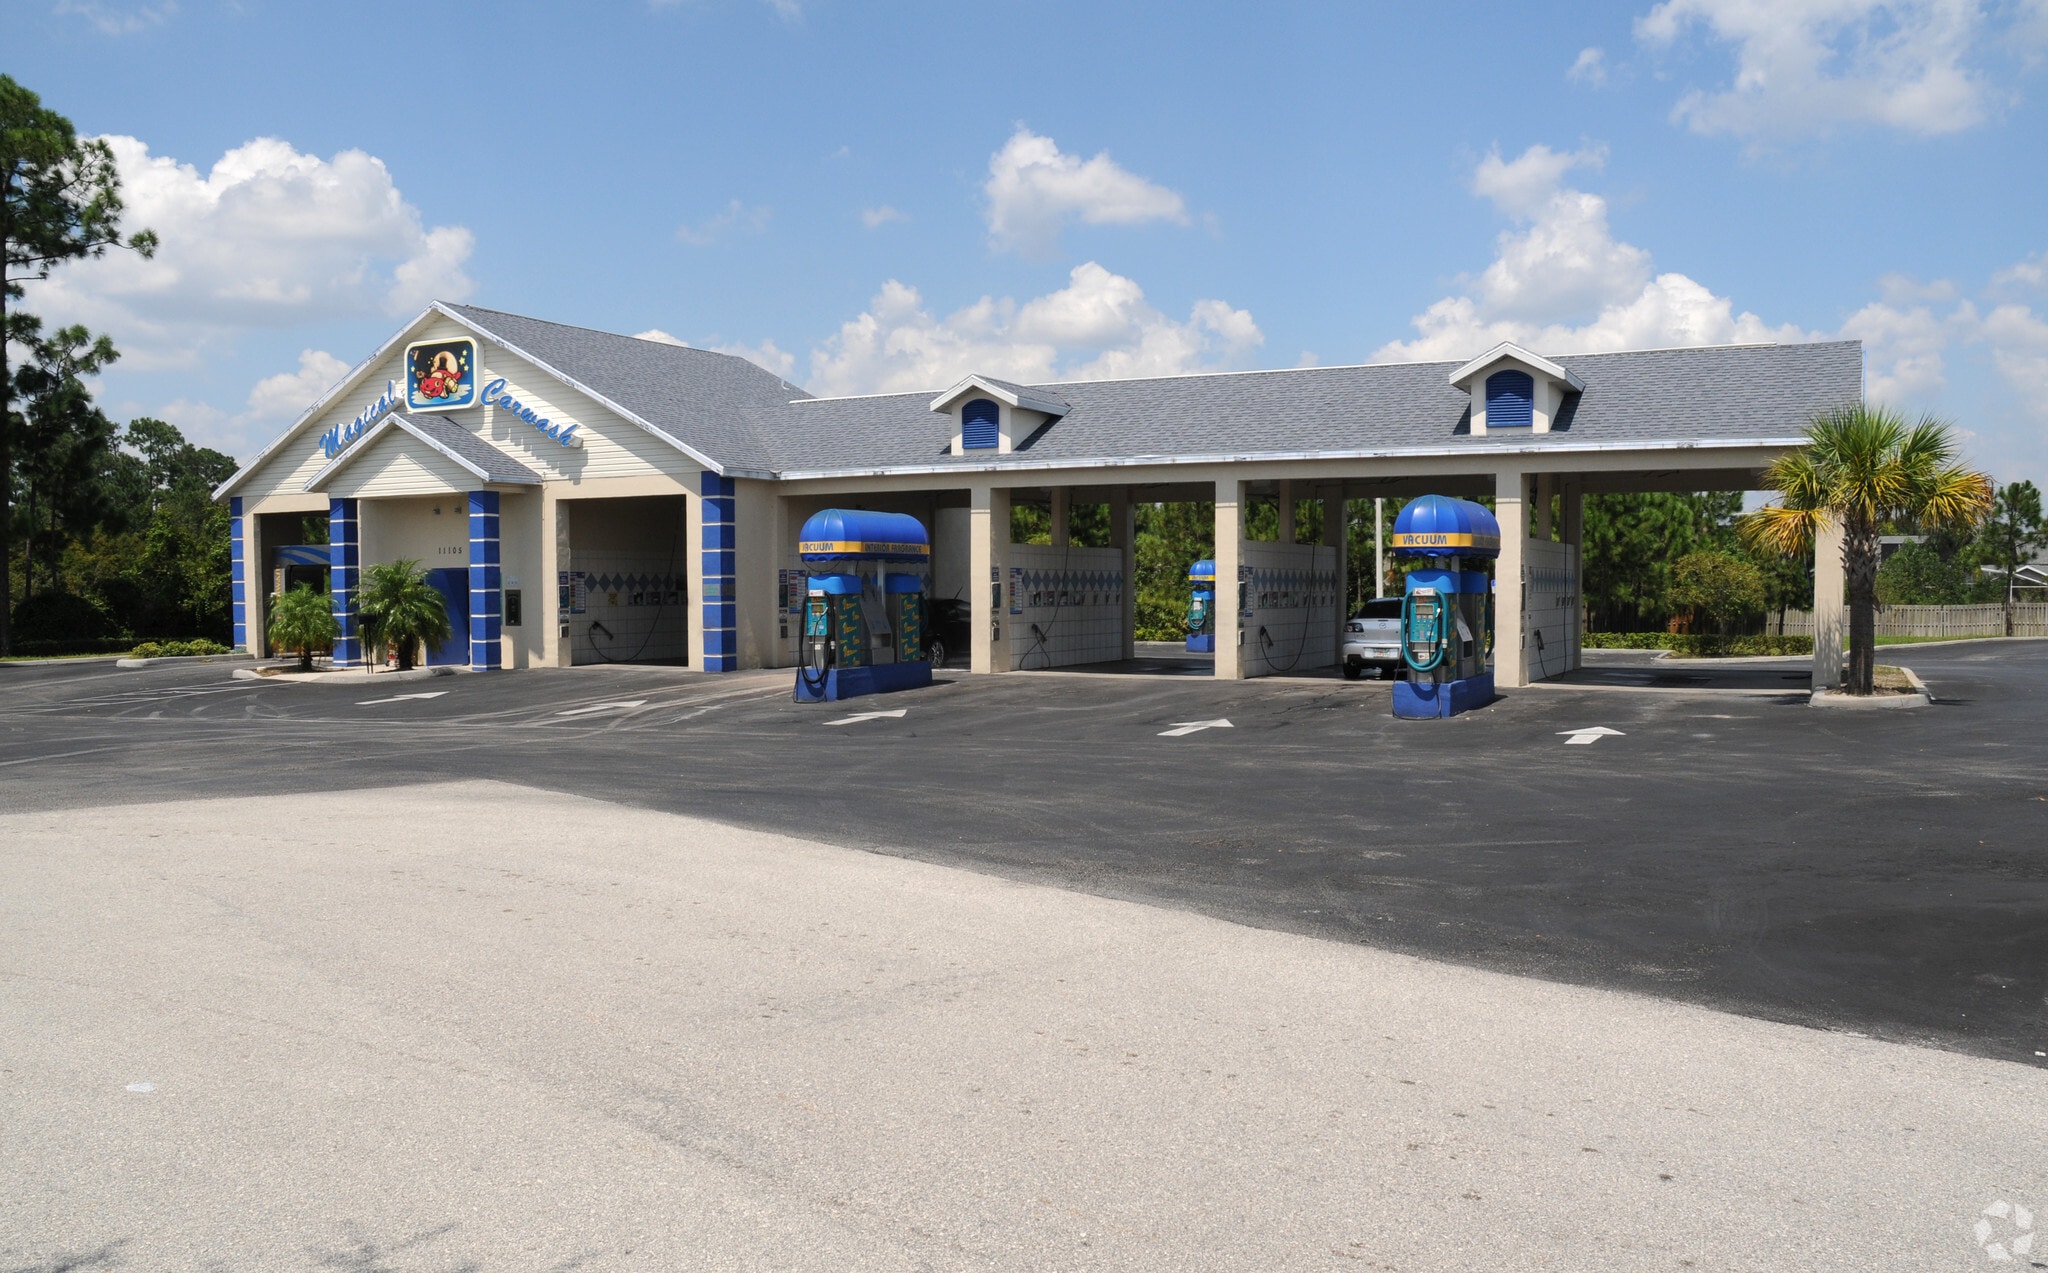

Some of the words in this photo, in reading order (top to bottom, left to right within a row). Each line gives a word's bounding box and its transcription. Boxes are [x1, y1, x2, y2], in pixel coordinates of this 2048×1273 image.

[319, 380, 396, 458] Magical
[481, 378, 580, 447] Carwash
[1403, 535, 1447, 545] VACUUM
